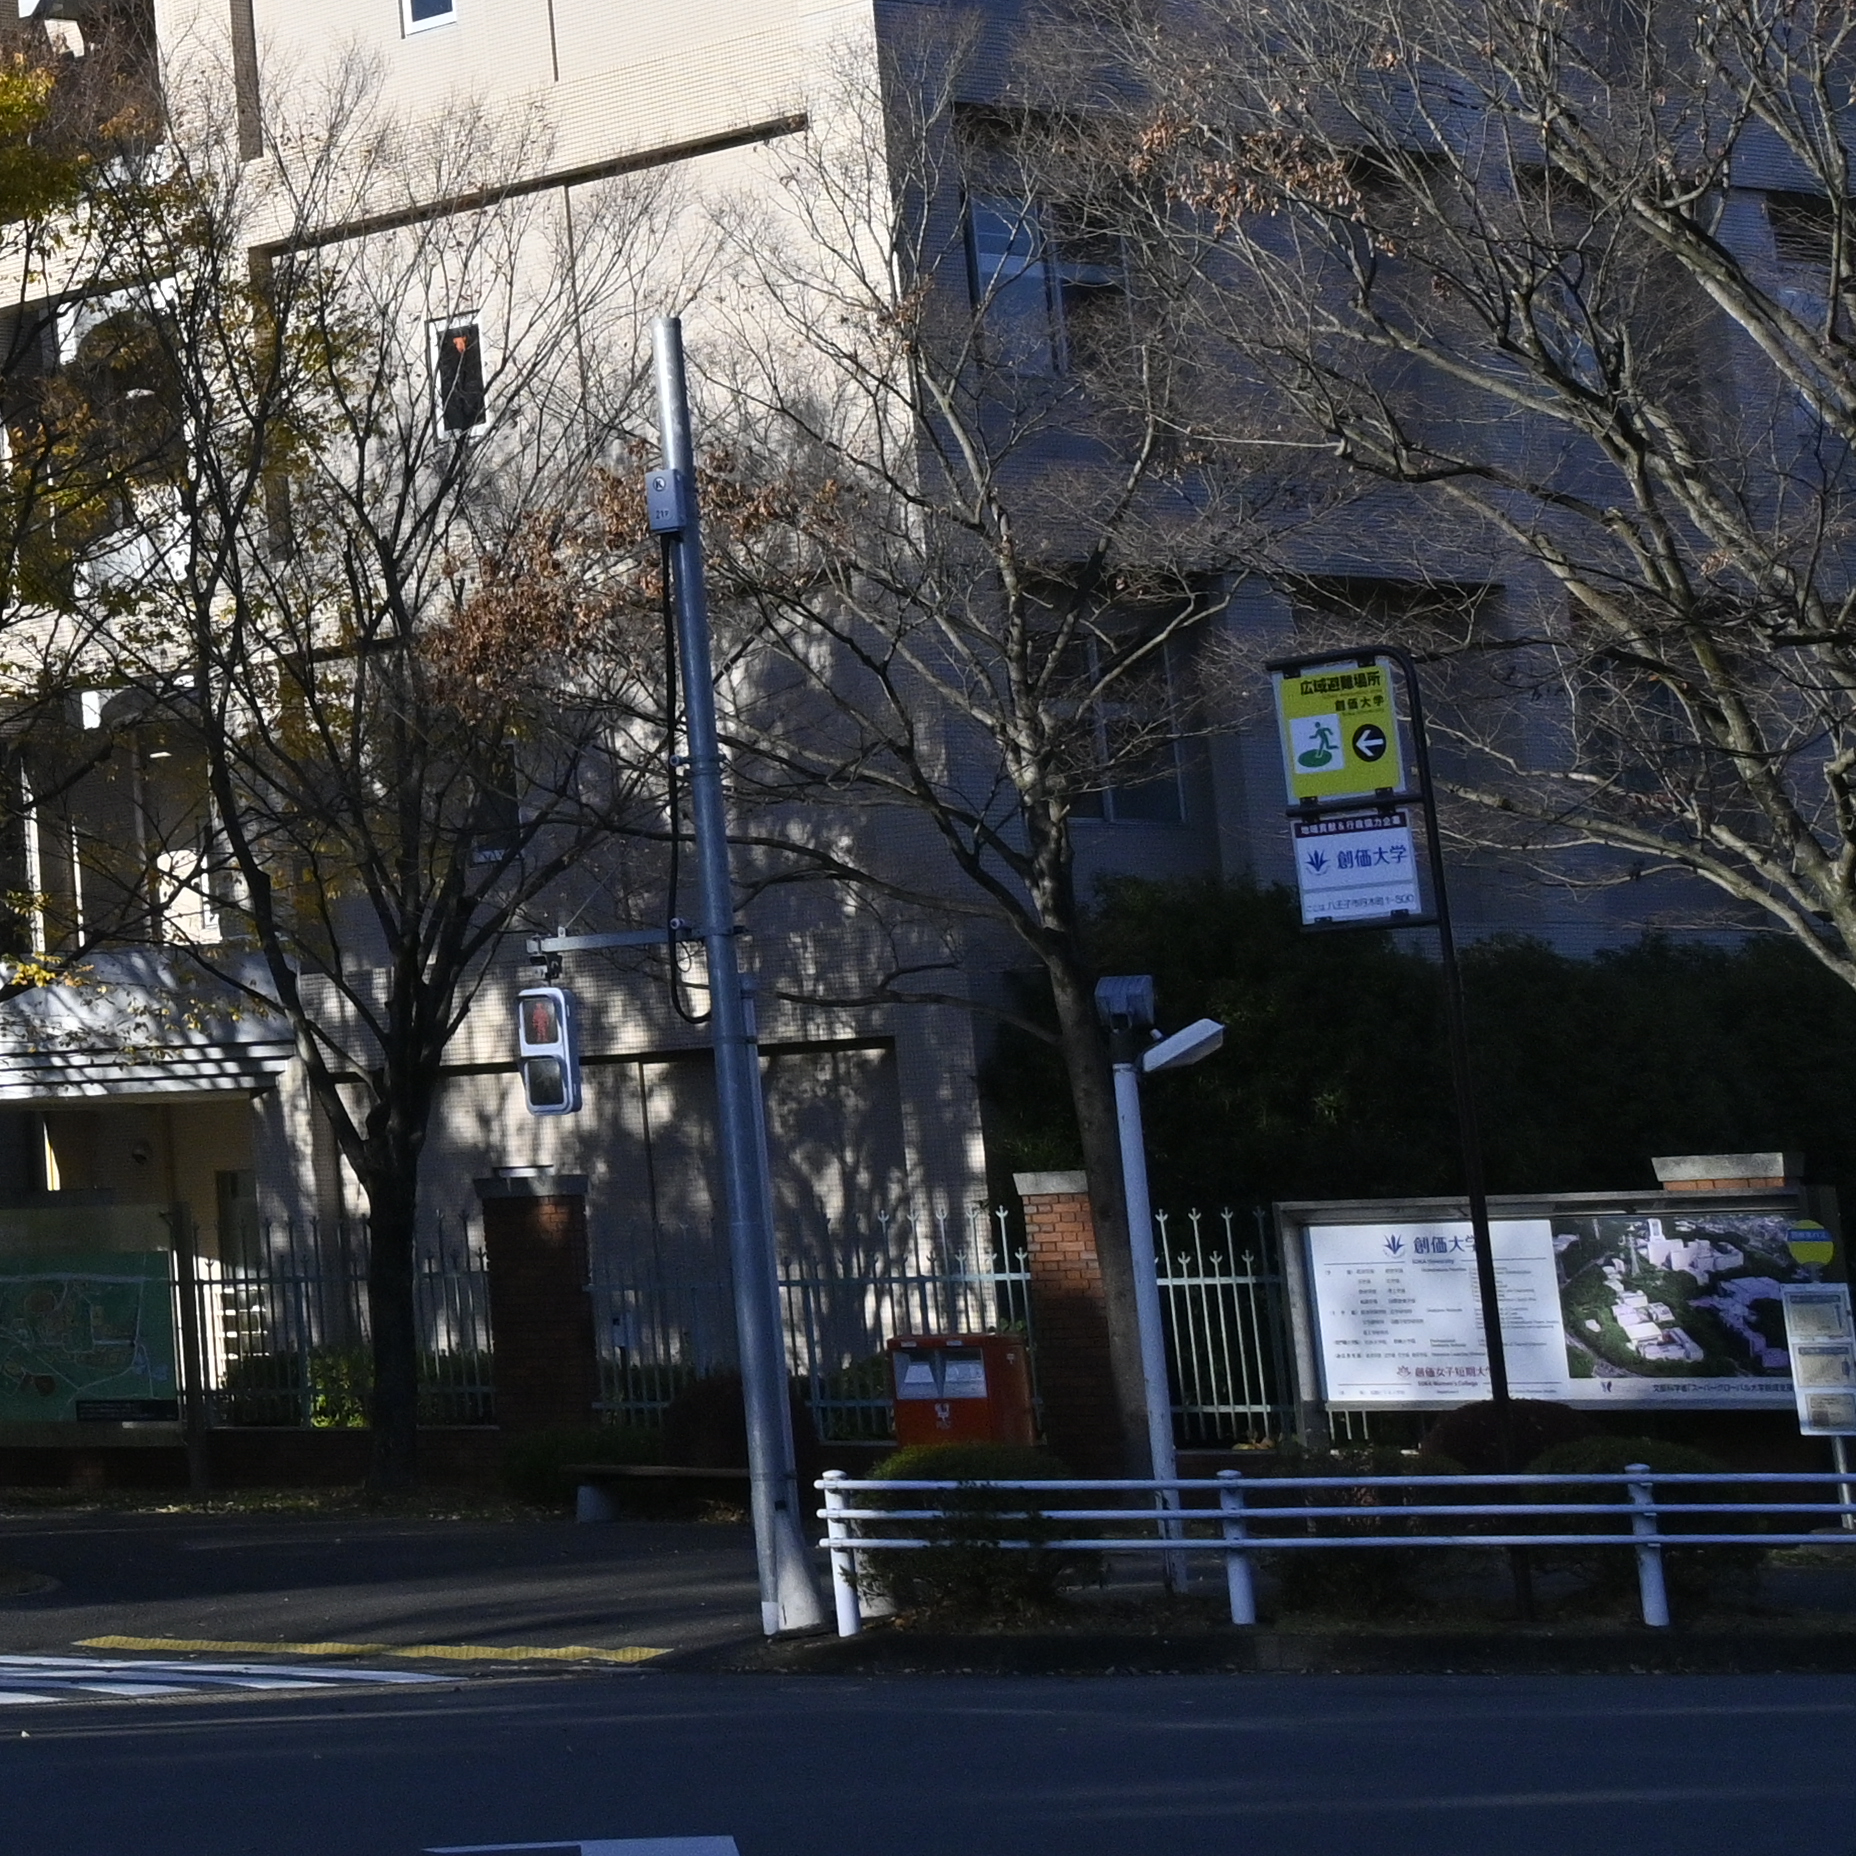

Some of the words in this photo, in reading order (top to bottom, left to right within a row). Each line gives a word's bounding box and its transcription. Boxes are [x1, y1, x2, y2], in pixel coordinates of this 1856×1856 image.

[1335, 695, 1385, 711] 創価大学
[1337, 844, 1407, 869] 創価大学
[1415, 1366, 1490, 1378] 創価女子短期大
